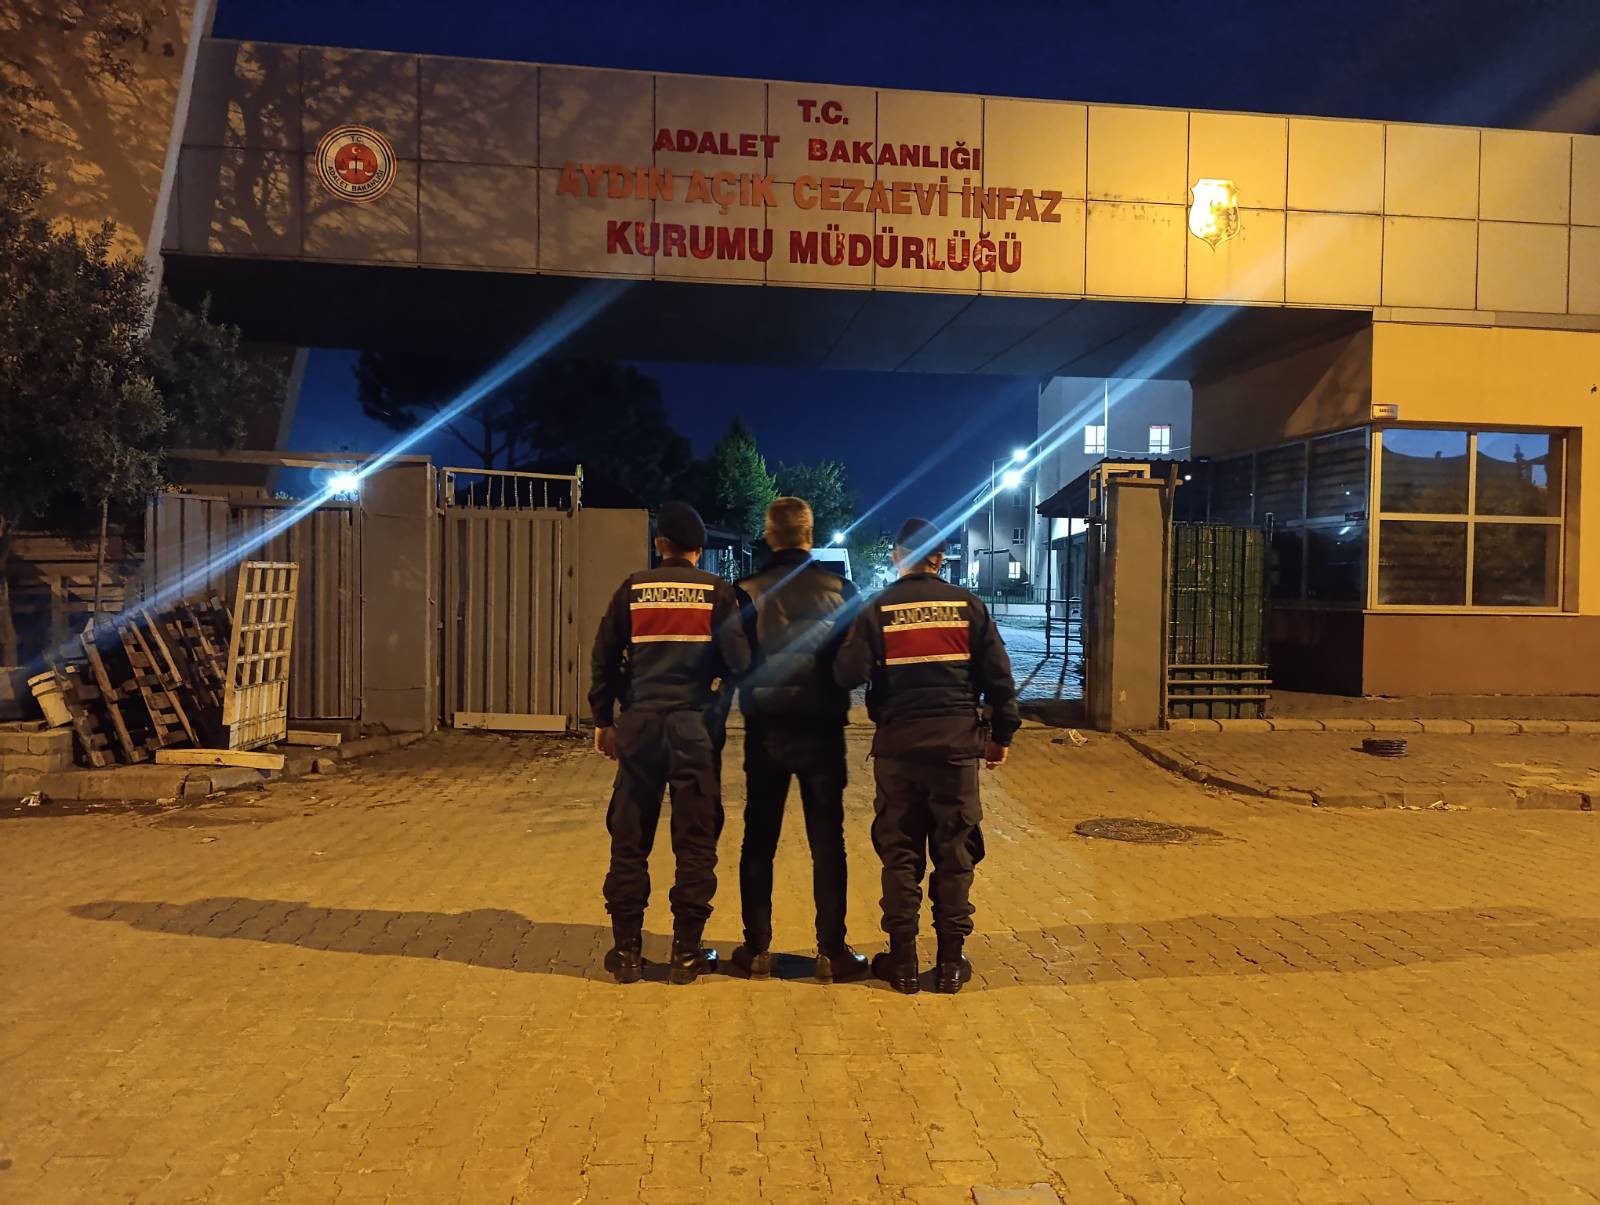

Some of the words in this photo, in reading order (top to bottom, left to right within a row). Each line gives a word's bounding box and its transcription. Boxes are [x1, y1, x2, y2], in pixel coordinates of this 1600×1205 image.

[797, 99, 848, 124] T.C.
[654, 128, 779, 158] ADALET
[809, 138, 981, 171] BAKANLIĞI
[328, 167, 349, 189] ADALET
[557, 161, 673, 201] AYDIN
[685, 171, 776, 215] AÇIK
[793, 175, 948, 216] CEZAEVİ
[962, 178, 1062, 223] İNFAZ
[607, 220, 773, 262] KURUMU
[790, 225, 1022, 273] MÜDÜRLÜĞÜ
[637, 588, 706, 603] JANDARMA
[890, 606, 962, 625] JANDARMA
